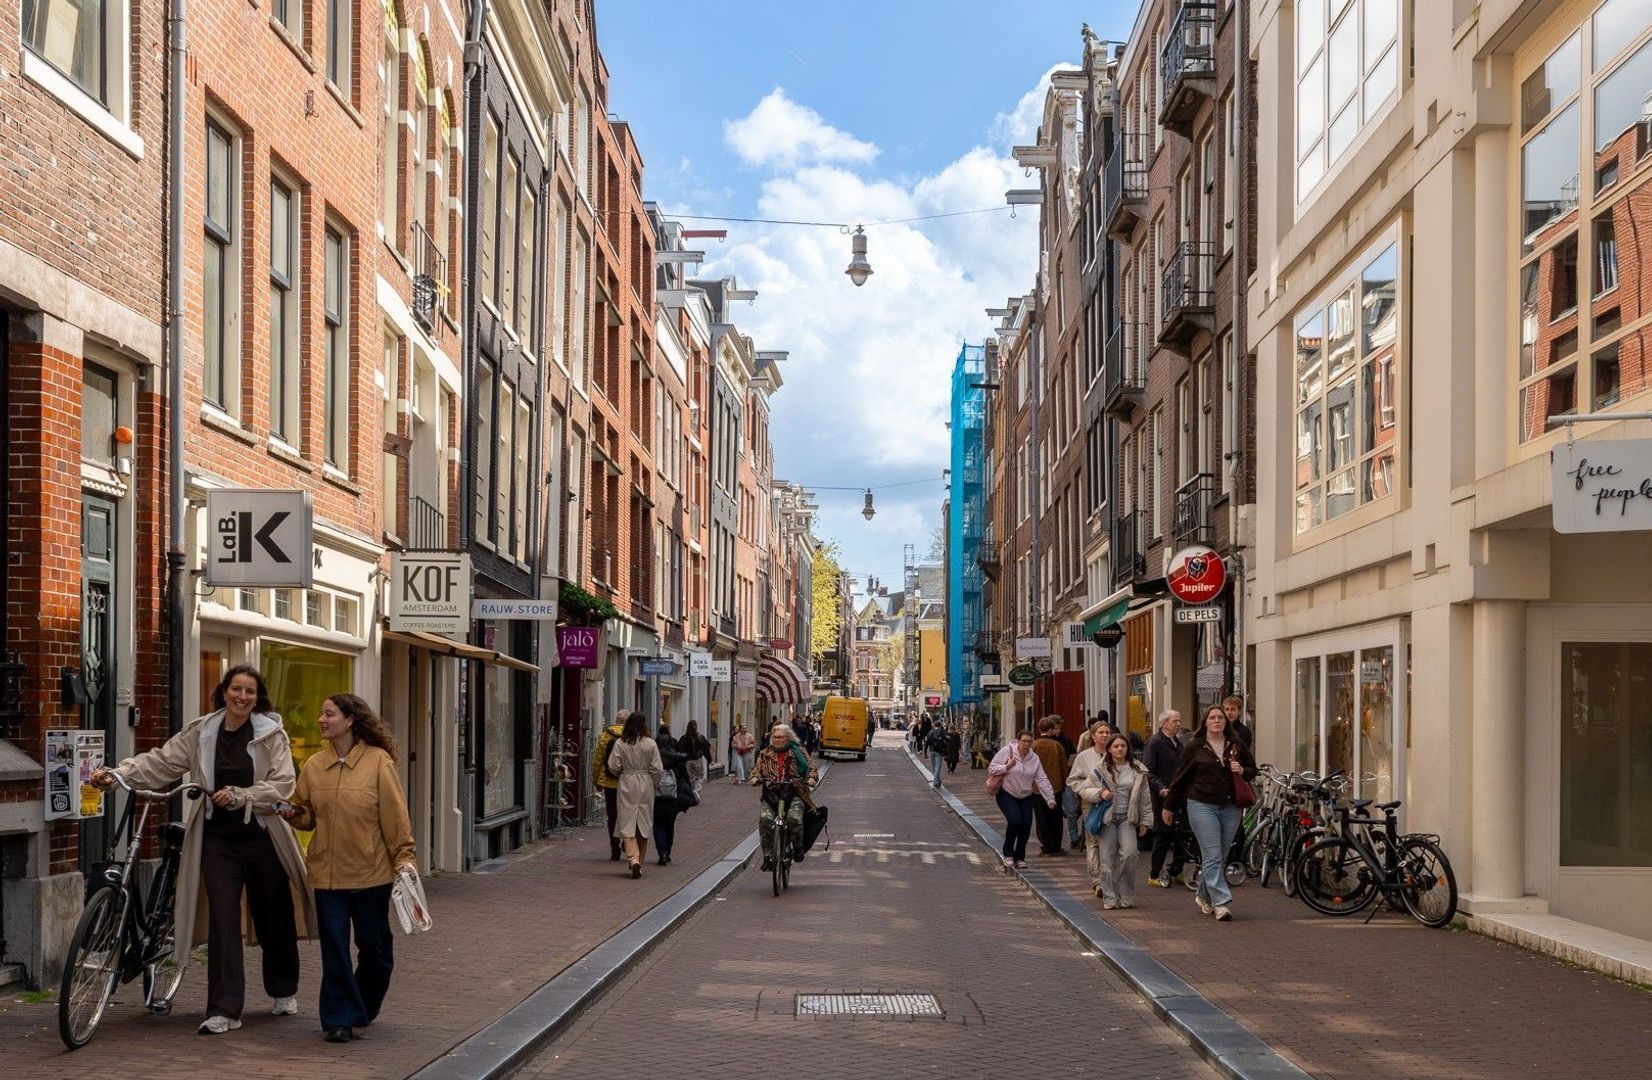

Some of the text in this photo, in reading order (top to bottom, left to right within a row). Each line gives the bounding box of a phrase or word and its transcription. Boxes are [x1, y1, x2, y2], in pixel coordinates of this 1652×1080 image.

[1567, 458, 1623, 490] free
[1592, 478, 1652, 516] people
[238, 511, 292, 563] K
[403, 565, 461, 602] KOF
[1179, 583, 1215, 594] Jupiler
[403, 604, 457, 612] AMSTERDAM
[481, 604, 553, 615] RAUW.STORE
[1179, 608, 1218, 621] DE PELS
[561, 630, 594, 651] jalò
